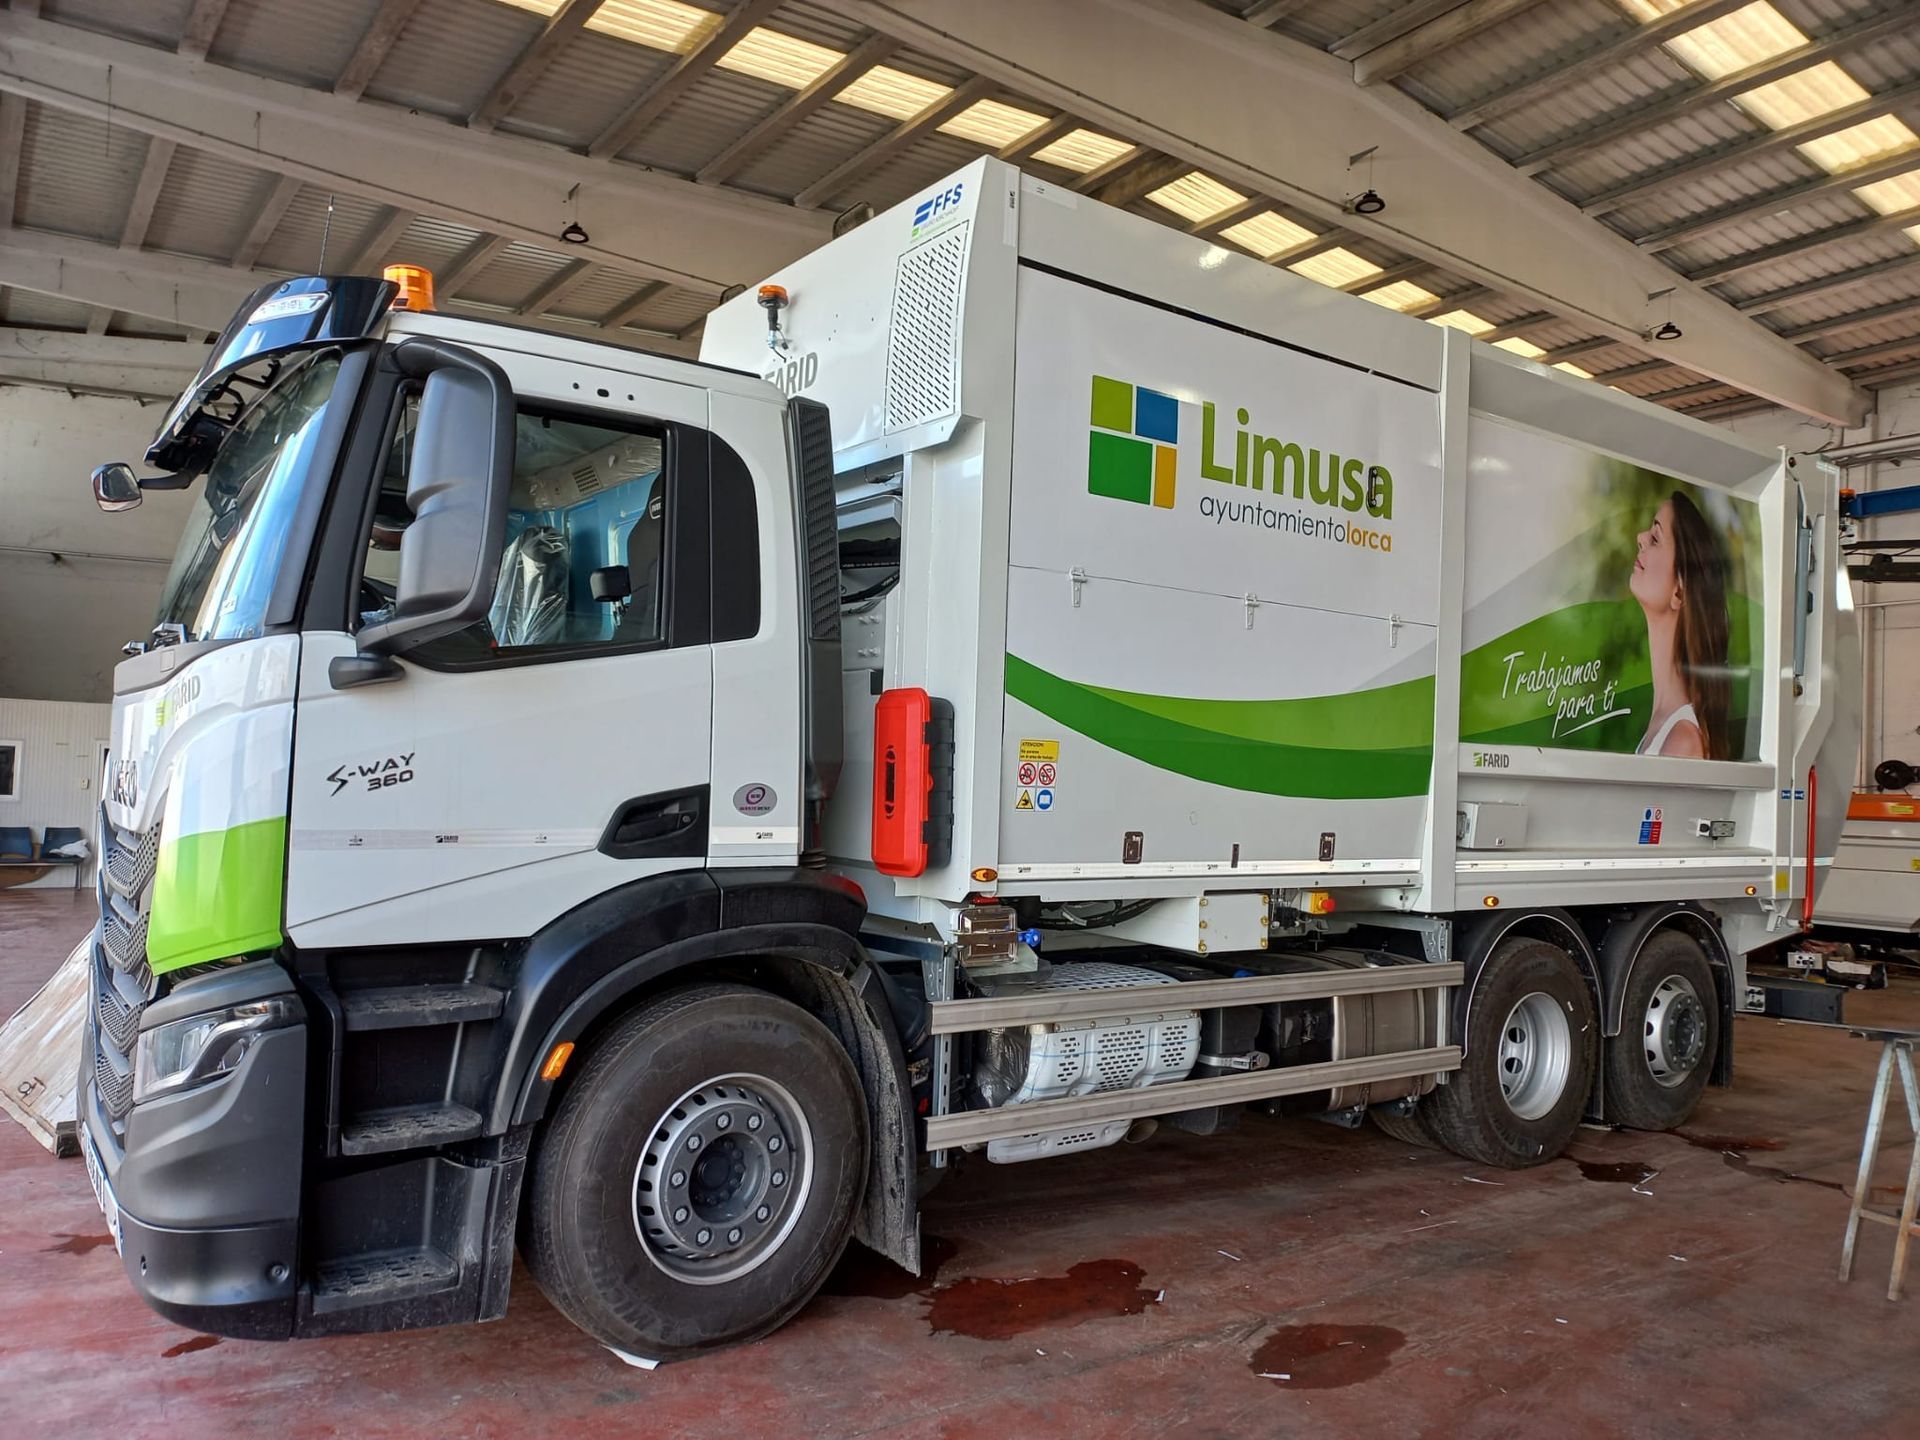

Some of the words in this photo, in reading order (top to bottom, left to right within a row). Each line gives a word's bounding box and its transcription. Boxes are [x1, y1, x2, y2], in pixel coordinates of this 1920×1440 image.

[933, 183, 963, 216] FFS
[1201, 400, 1393, 520] Limusa
[1502, 650, 1601, 707] Trabajamos
[1552, 693, 1595, 739] para
[1603, 680, 1619, 712] ti
[326, 752, 415, 797] S-WAY
[367, 769, 414, 792] 360
[1482, 753, 1510, 768] FARID
